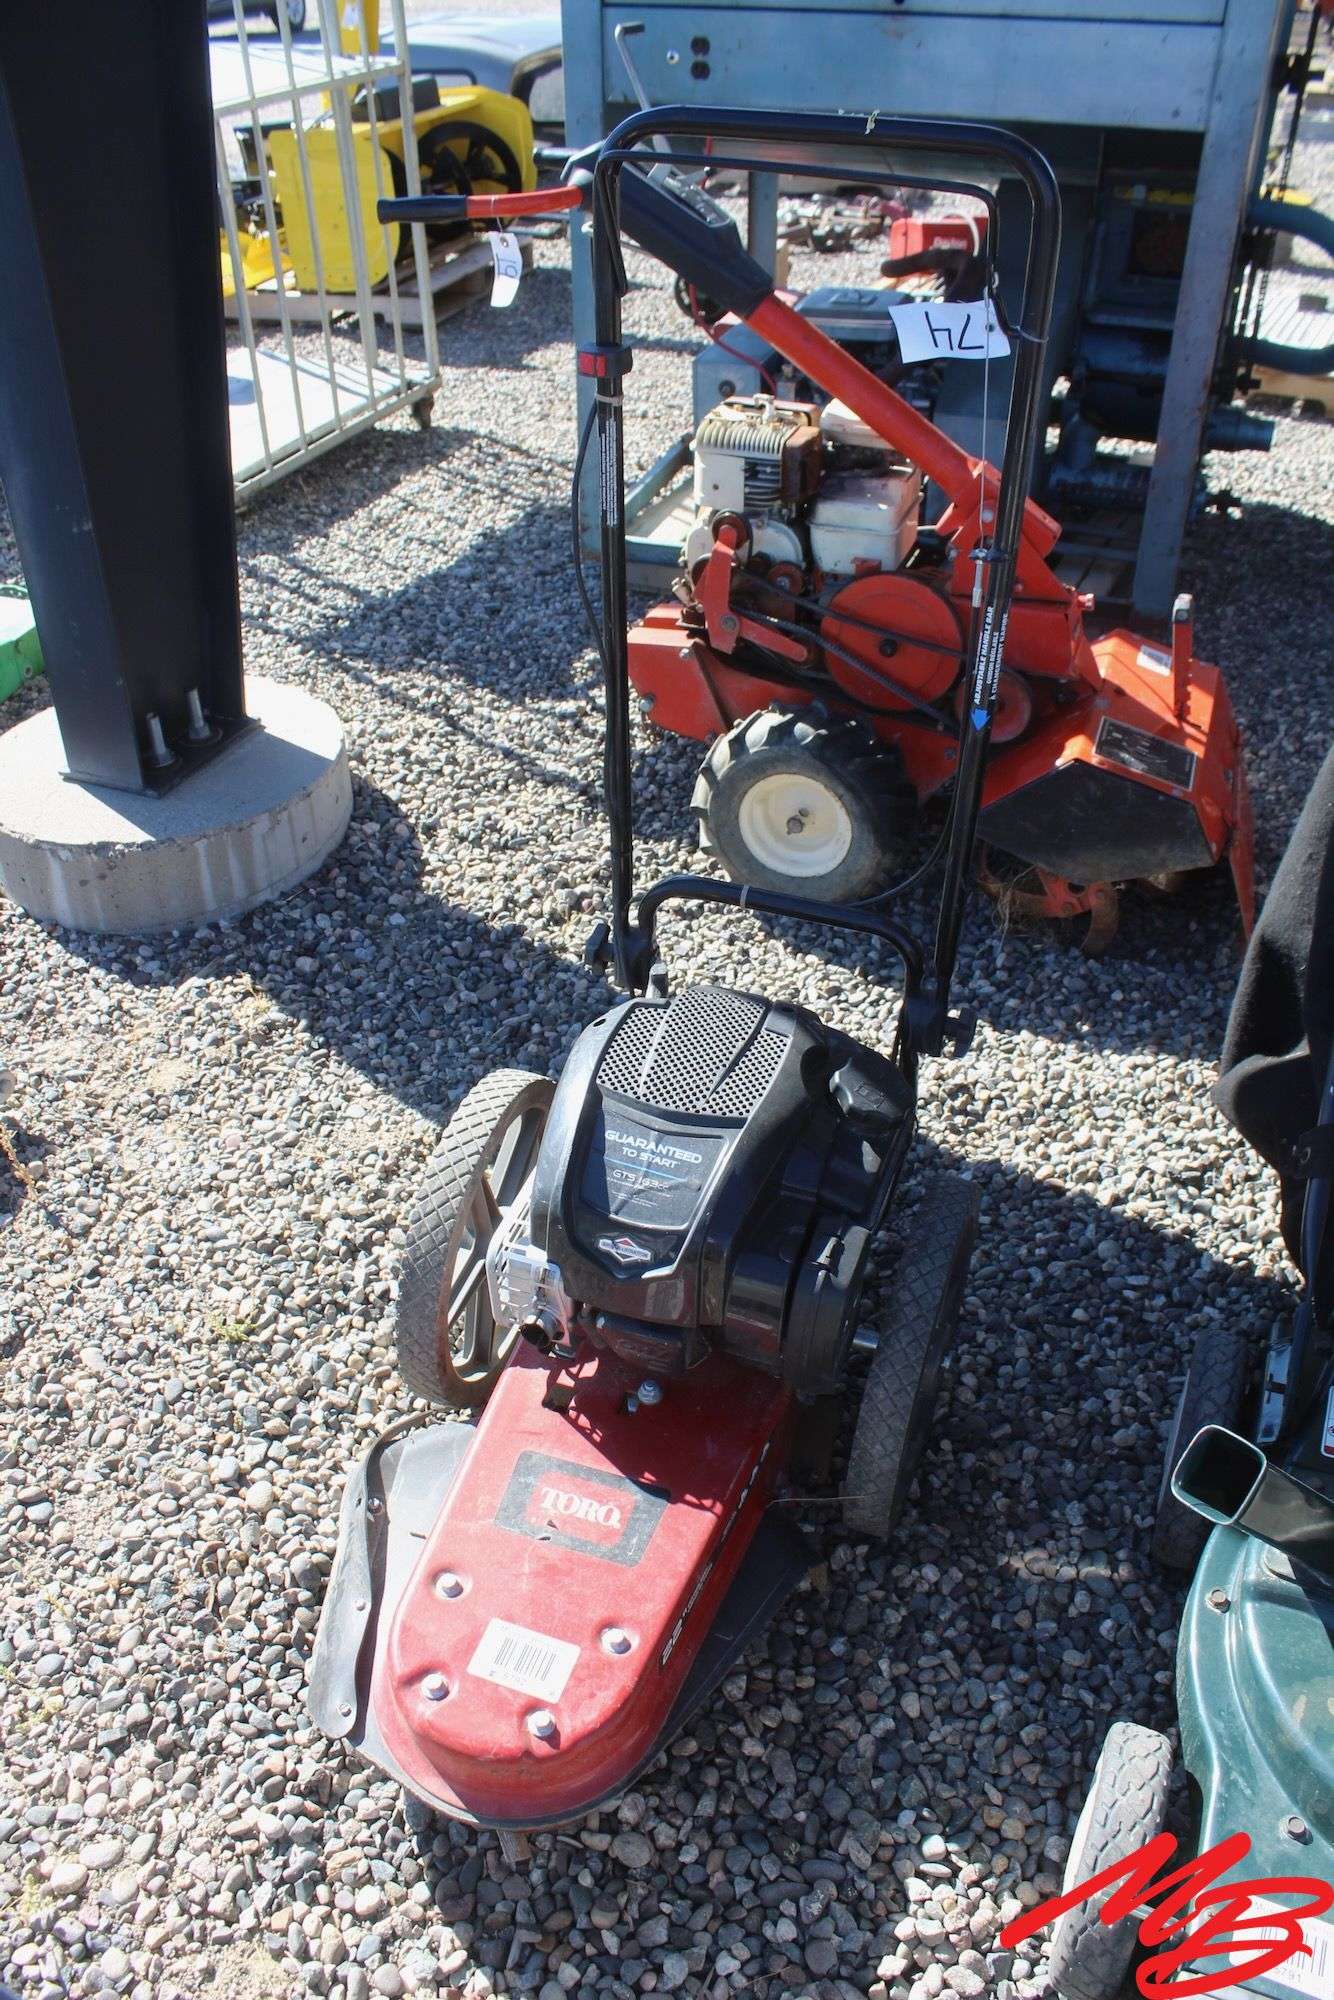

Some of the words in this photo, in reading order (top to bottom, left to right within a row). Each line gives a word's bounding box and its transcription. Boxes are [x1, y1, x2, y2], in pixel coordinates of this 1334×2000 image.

[924, 311, 985, 351] 74
[974, 655, 986, 704] ADJUSTABLE
[981, 624, 991, 655] HANDLE
[986, 606, 994, 623] BAR
[605, 1130, 702, 1164] GUARANTEED
[622, 1146, 638, 1158] TO
[612, 1169, 636, 1182] GTS
[541, 1487, 621, 1529] TORO
